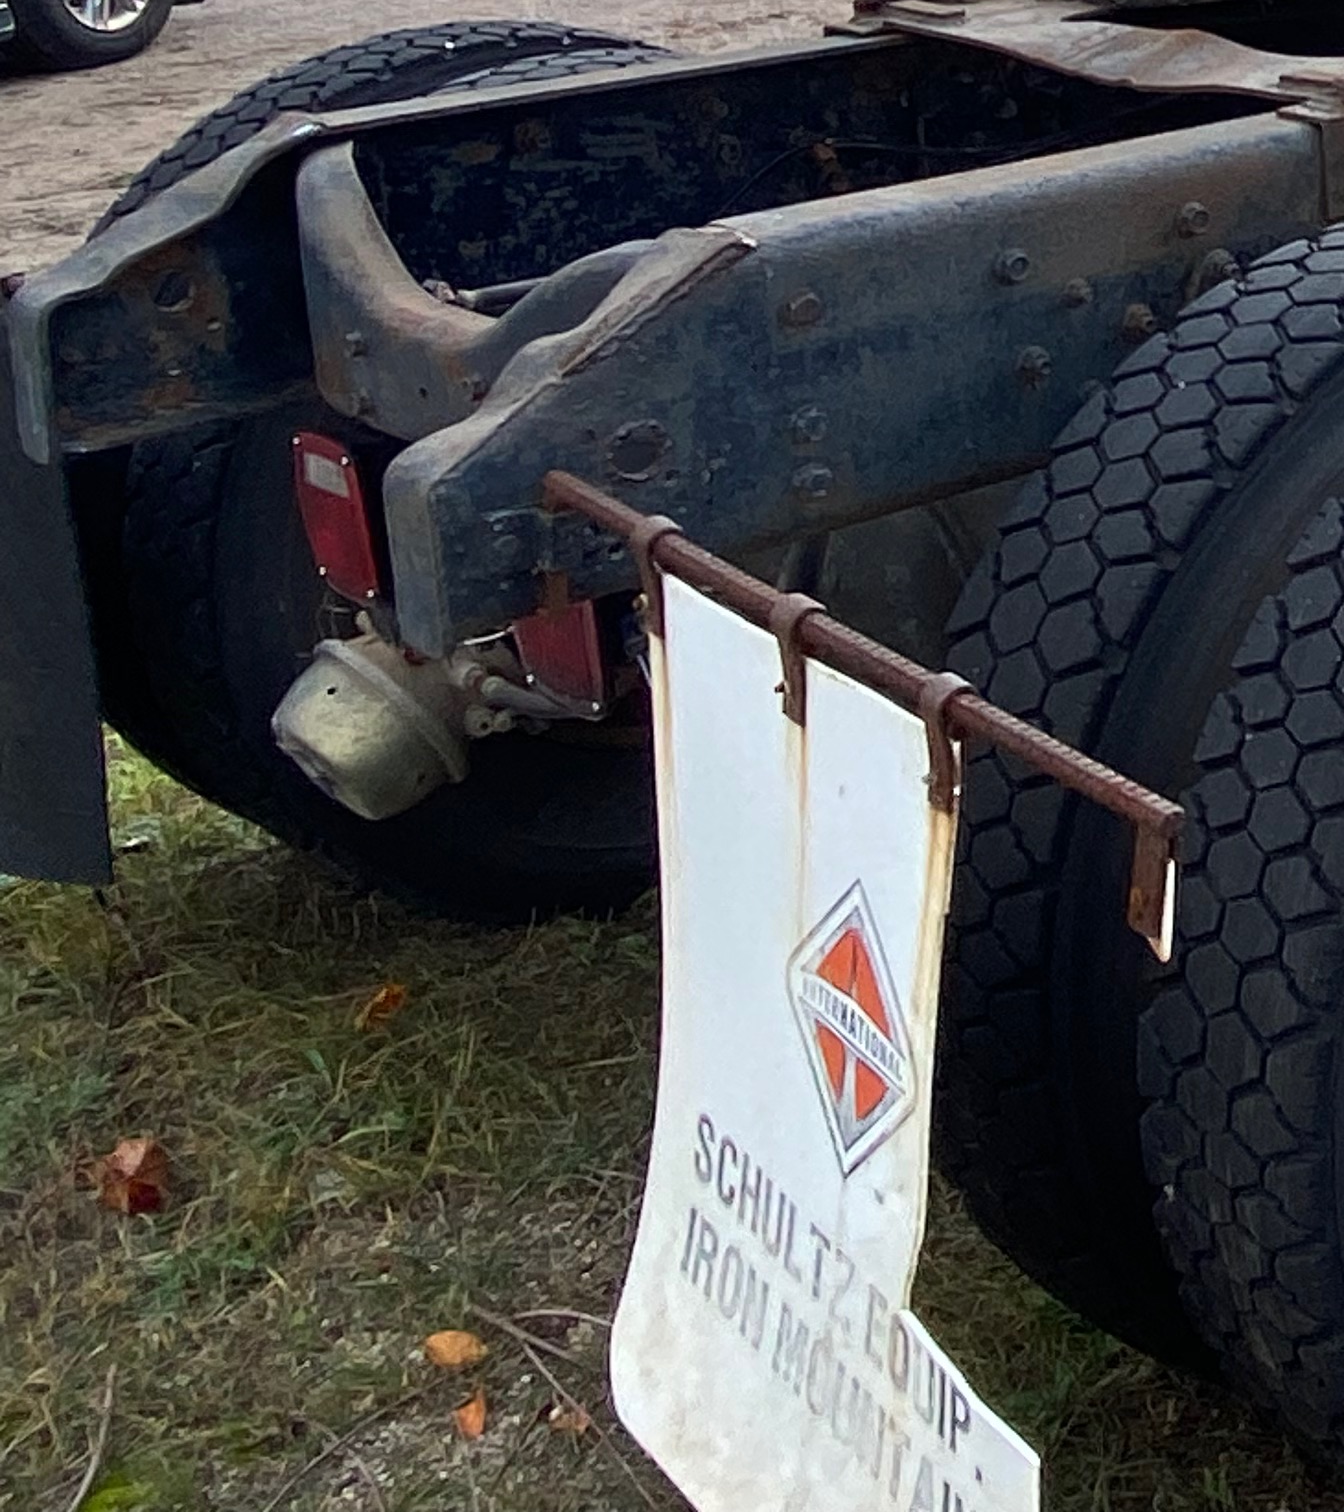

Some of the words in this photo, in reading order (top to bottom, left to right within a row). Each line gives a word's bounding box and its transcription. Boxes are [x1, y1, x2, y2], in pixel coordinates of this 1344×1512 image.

[802, 976, 902, 1082] INTERNATIONAL
[680, 1207, 769, 1351] IRON
[694, 1113, 856, 1334] SCHULTZ
